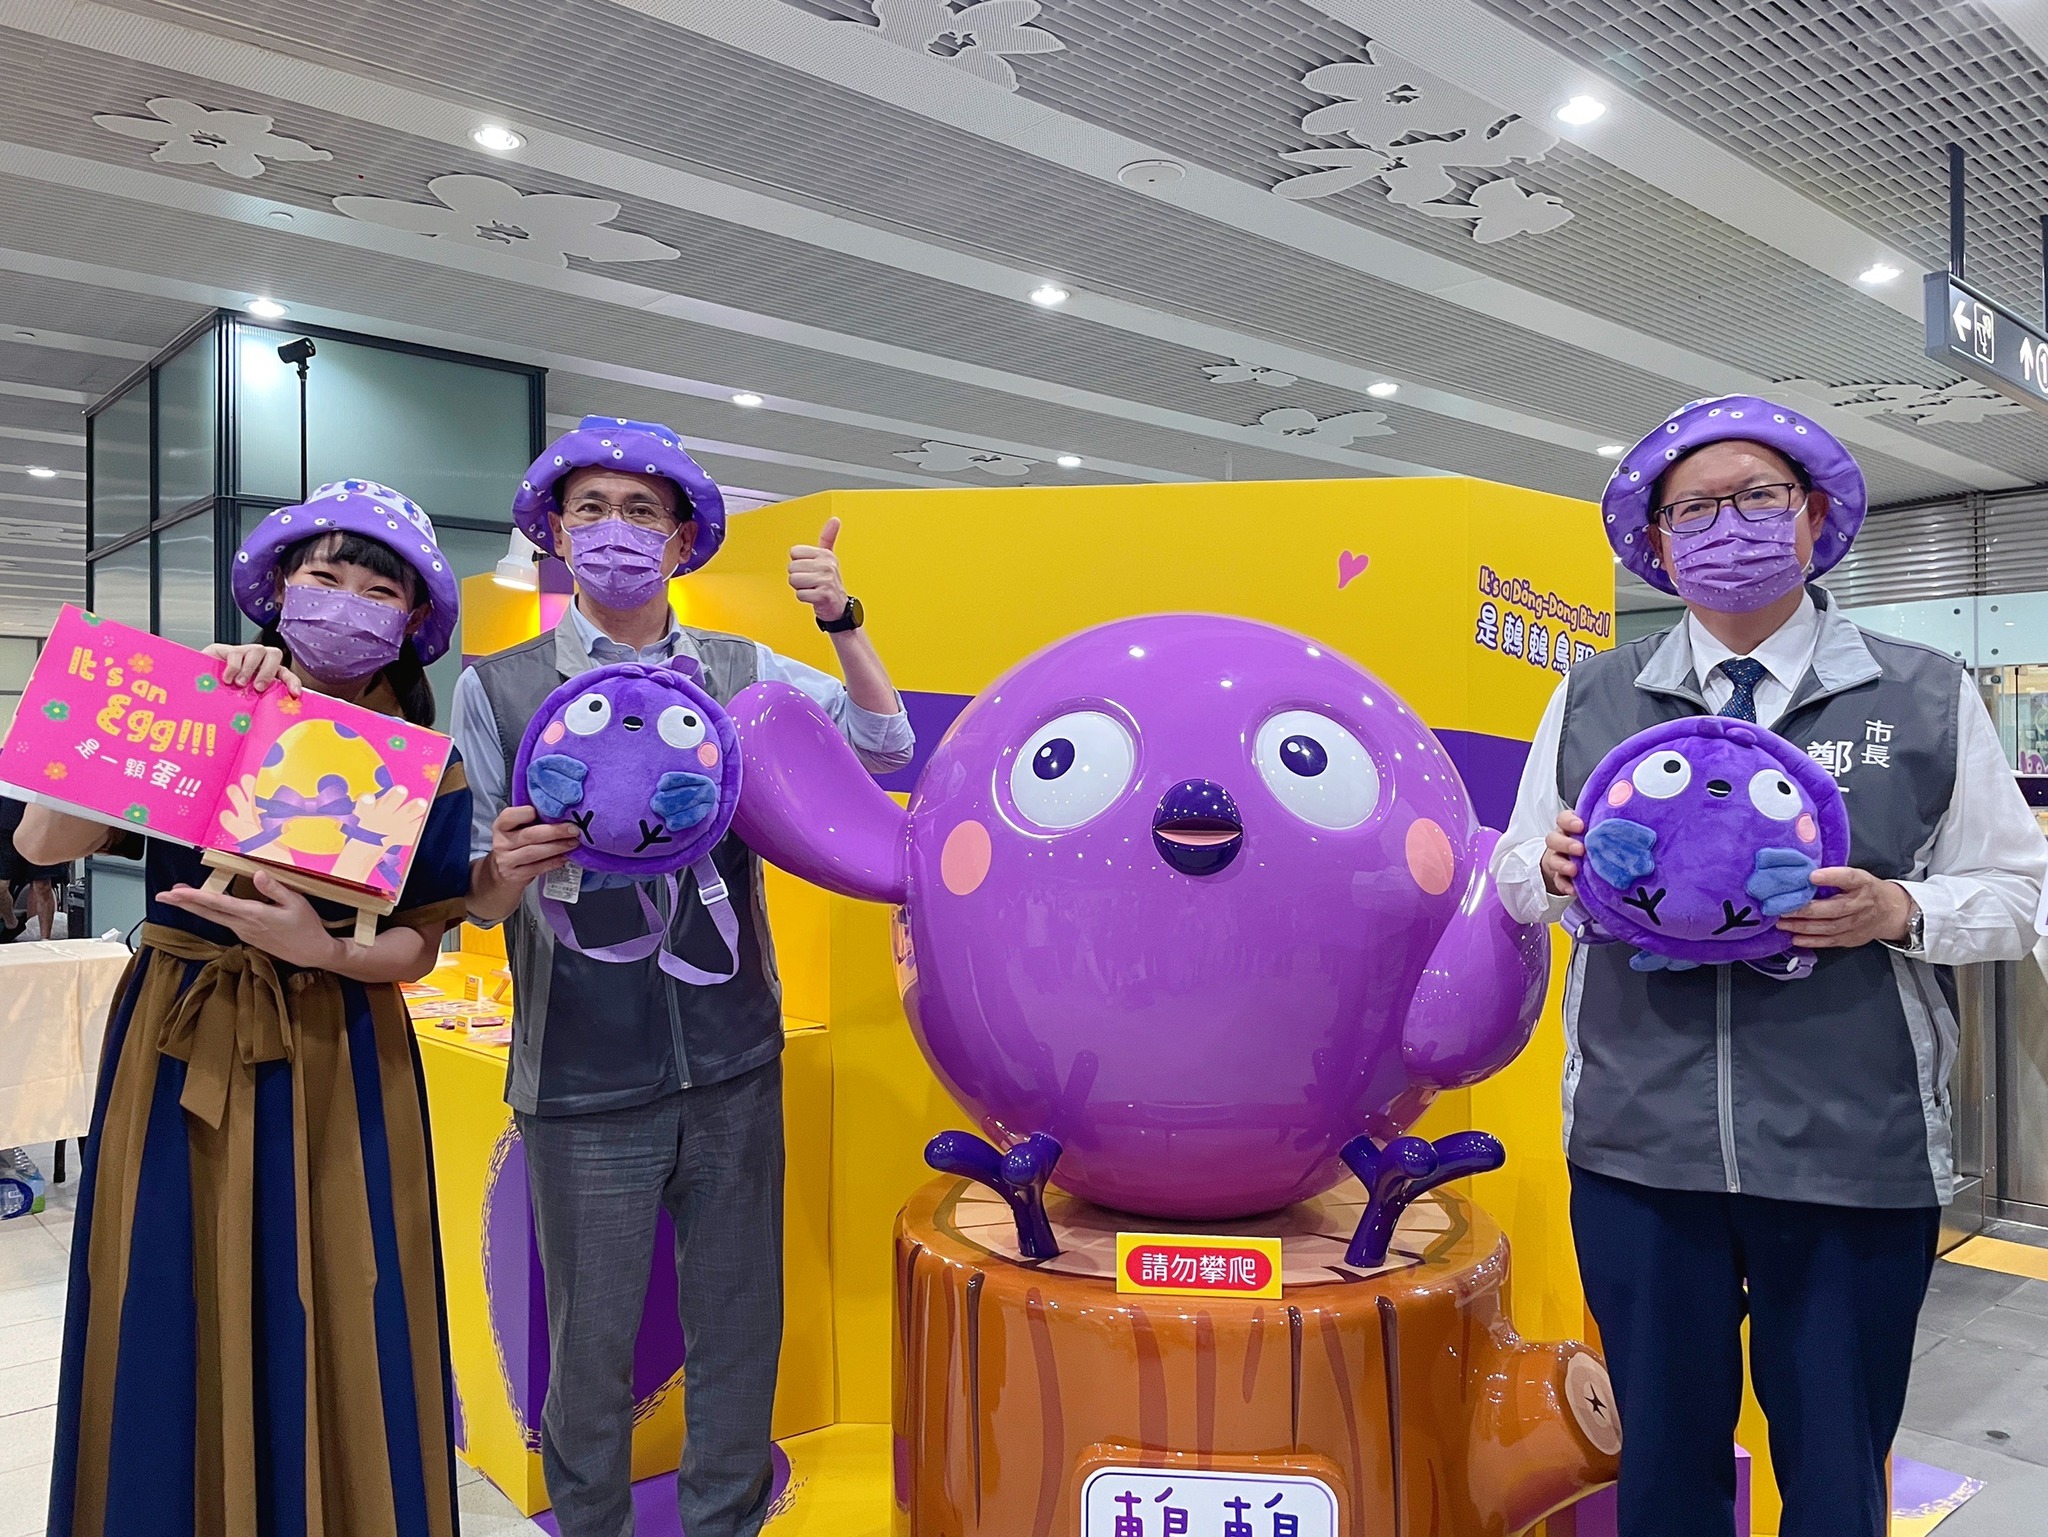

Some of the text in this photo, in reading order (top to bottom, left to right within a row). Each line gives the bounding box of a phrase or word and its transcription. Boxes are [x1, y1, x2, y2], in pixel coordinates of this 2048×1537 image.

[1479, 565, 1500, 598] It's
[1501, 580, 1511, 601] a
[67, 646, 168, 704] It's an
[96, 693, 217, 757] Egg!!!
[1860, 719, 1895, 769] 市長
[1806, 740, 1854, 793] 鄭
[1141, 1253, 1256, 1286] 請勿攀爬
